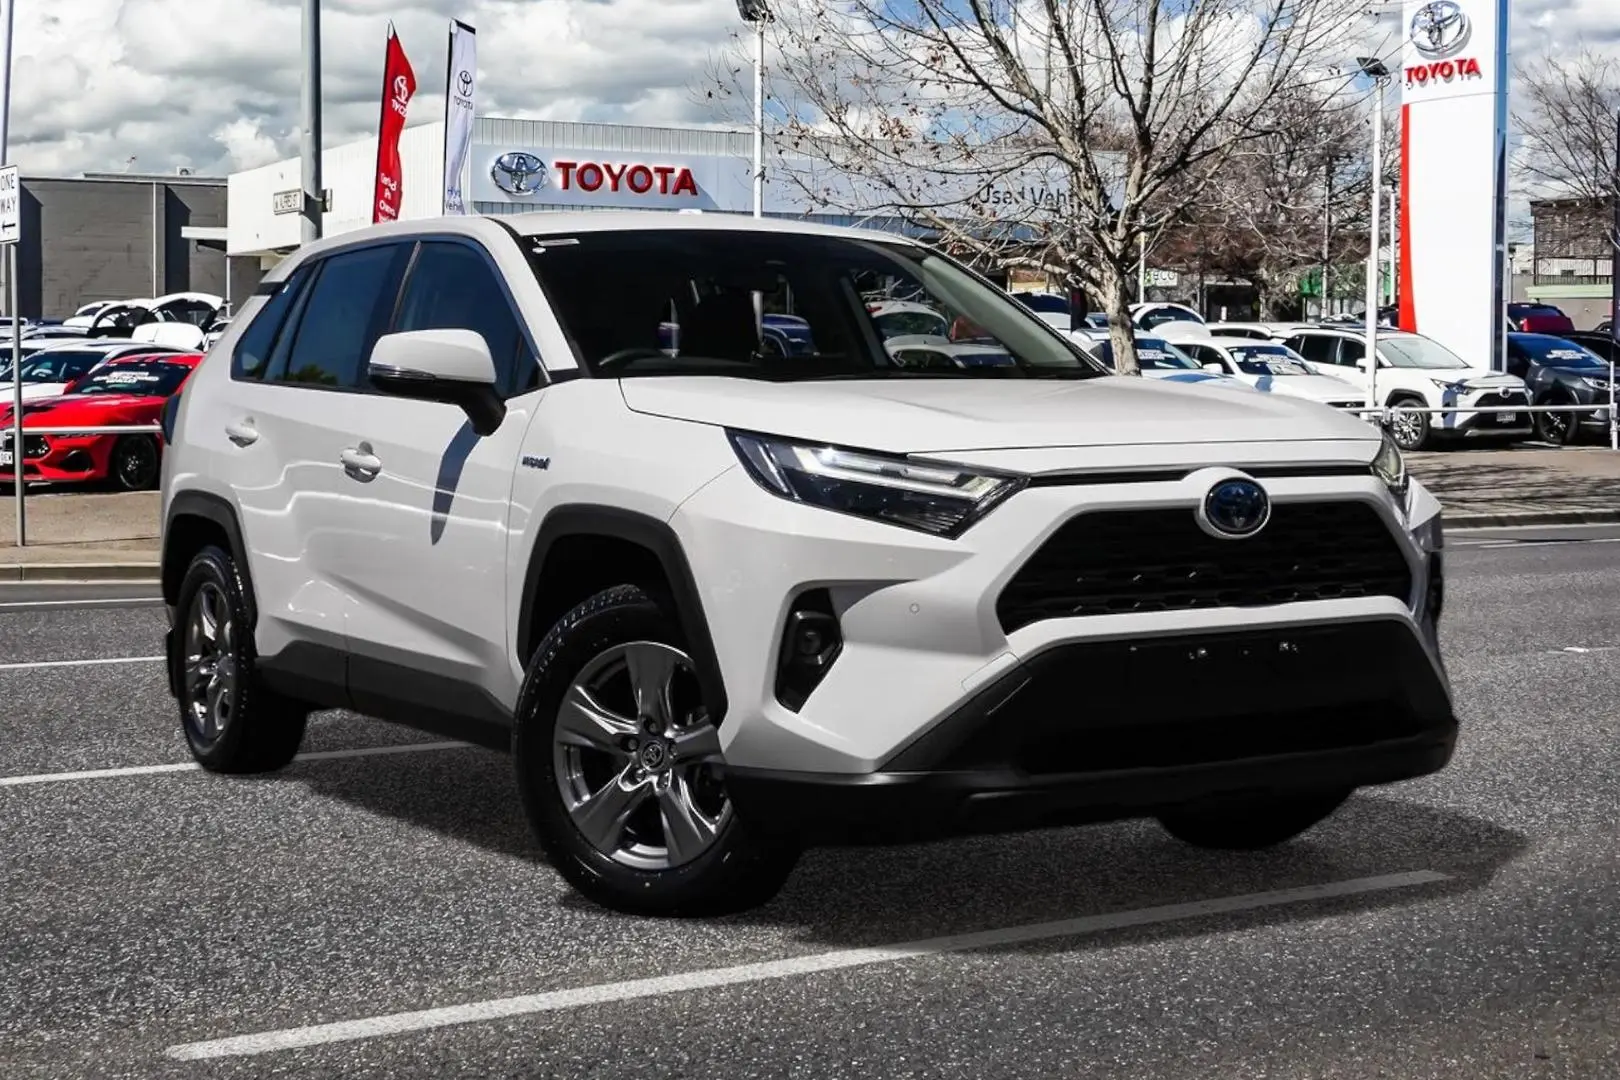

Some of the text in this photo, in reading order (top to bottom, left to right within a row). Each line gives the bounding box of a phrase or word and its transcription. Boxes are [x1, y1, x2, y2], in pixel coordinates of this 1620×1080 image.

[1404, 58, 1481, 83] TOYOTA
[0, 173, 15, 191] ONE
[554, 161, 698, 196] TOYOTA
[979, 183, 1025, 204] Used
[0, 196, 16, 214] WAY
